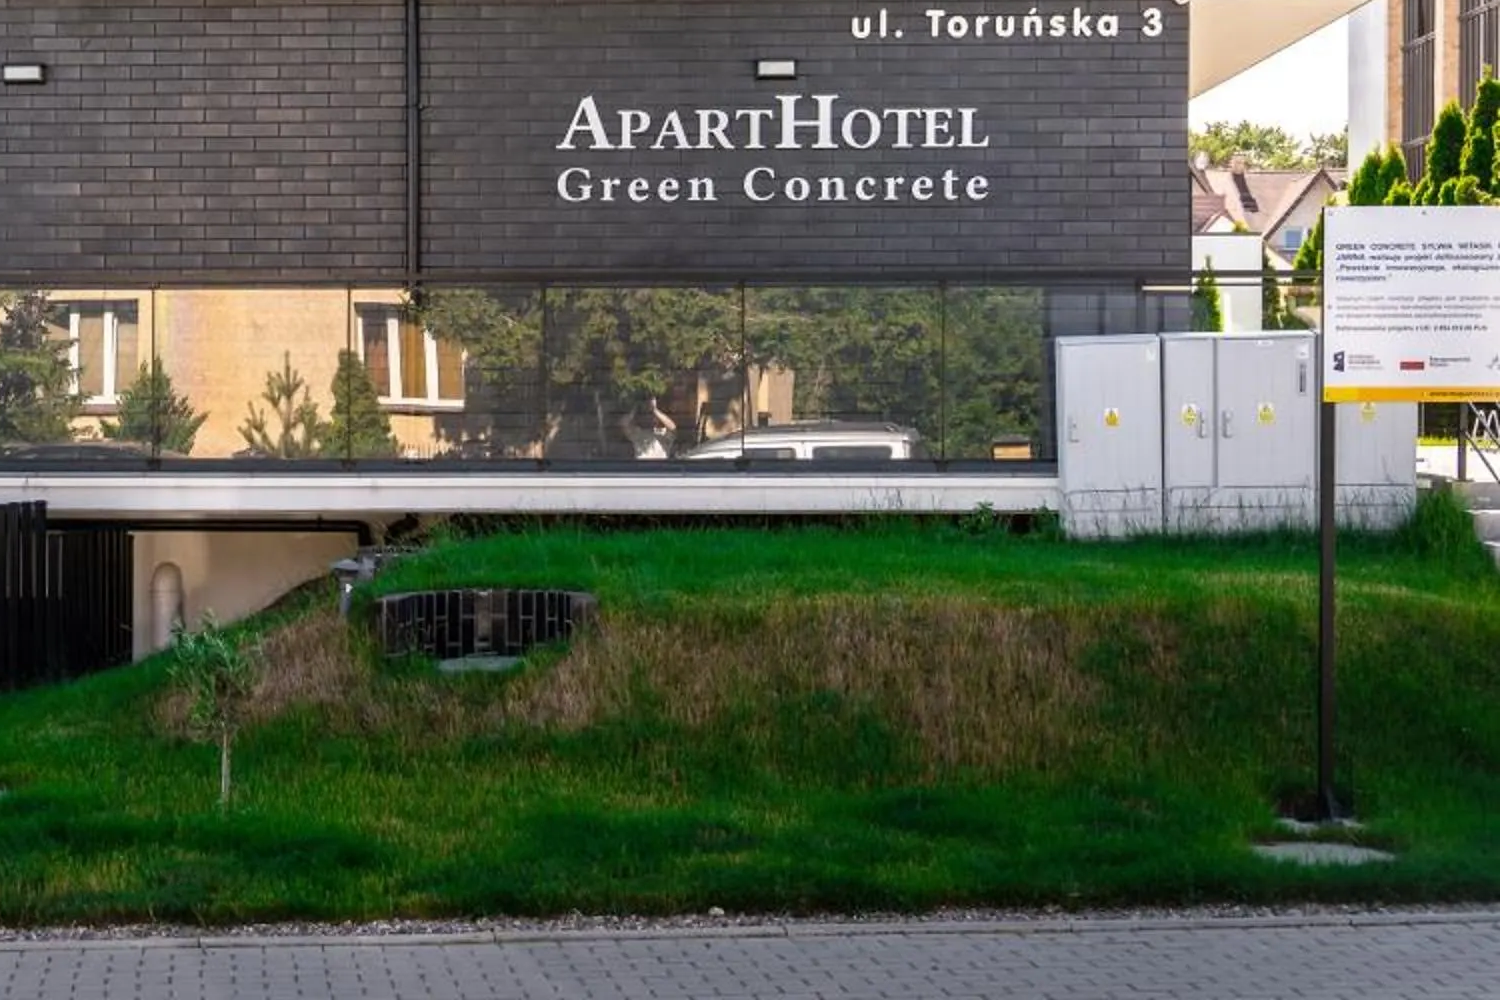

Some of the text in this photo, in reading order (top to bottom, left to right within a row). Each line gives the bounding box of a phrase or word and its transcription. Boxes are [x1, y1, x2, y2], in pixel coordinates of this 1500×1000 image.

[851, 6, 1163, 39] ul. Toruńska 3
[557, 167, 989, 202] Green Concrete
